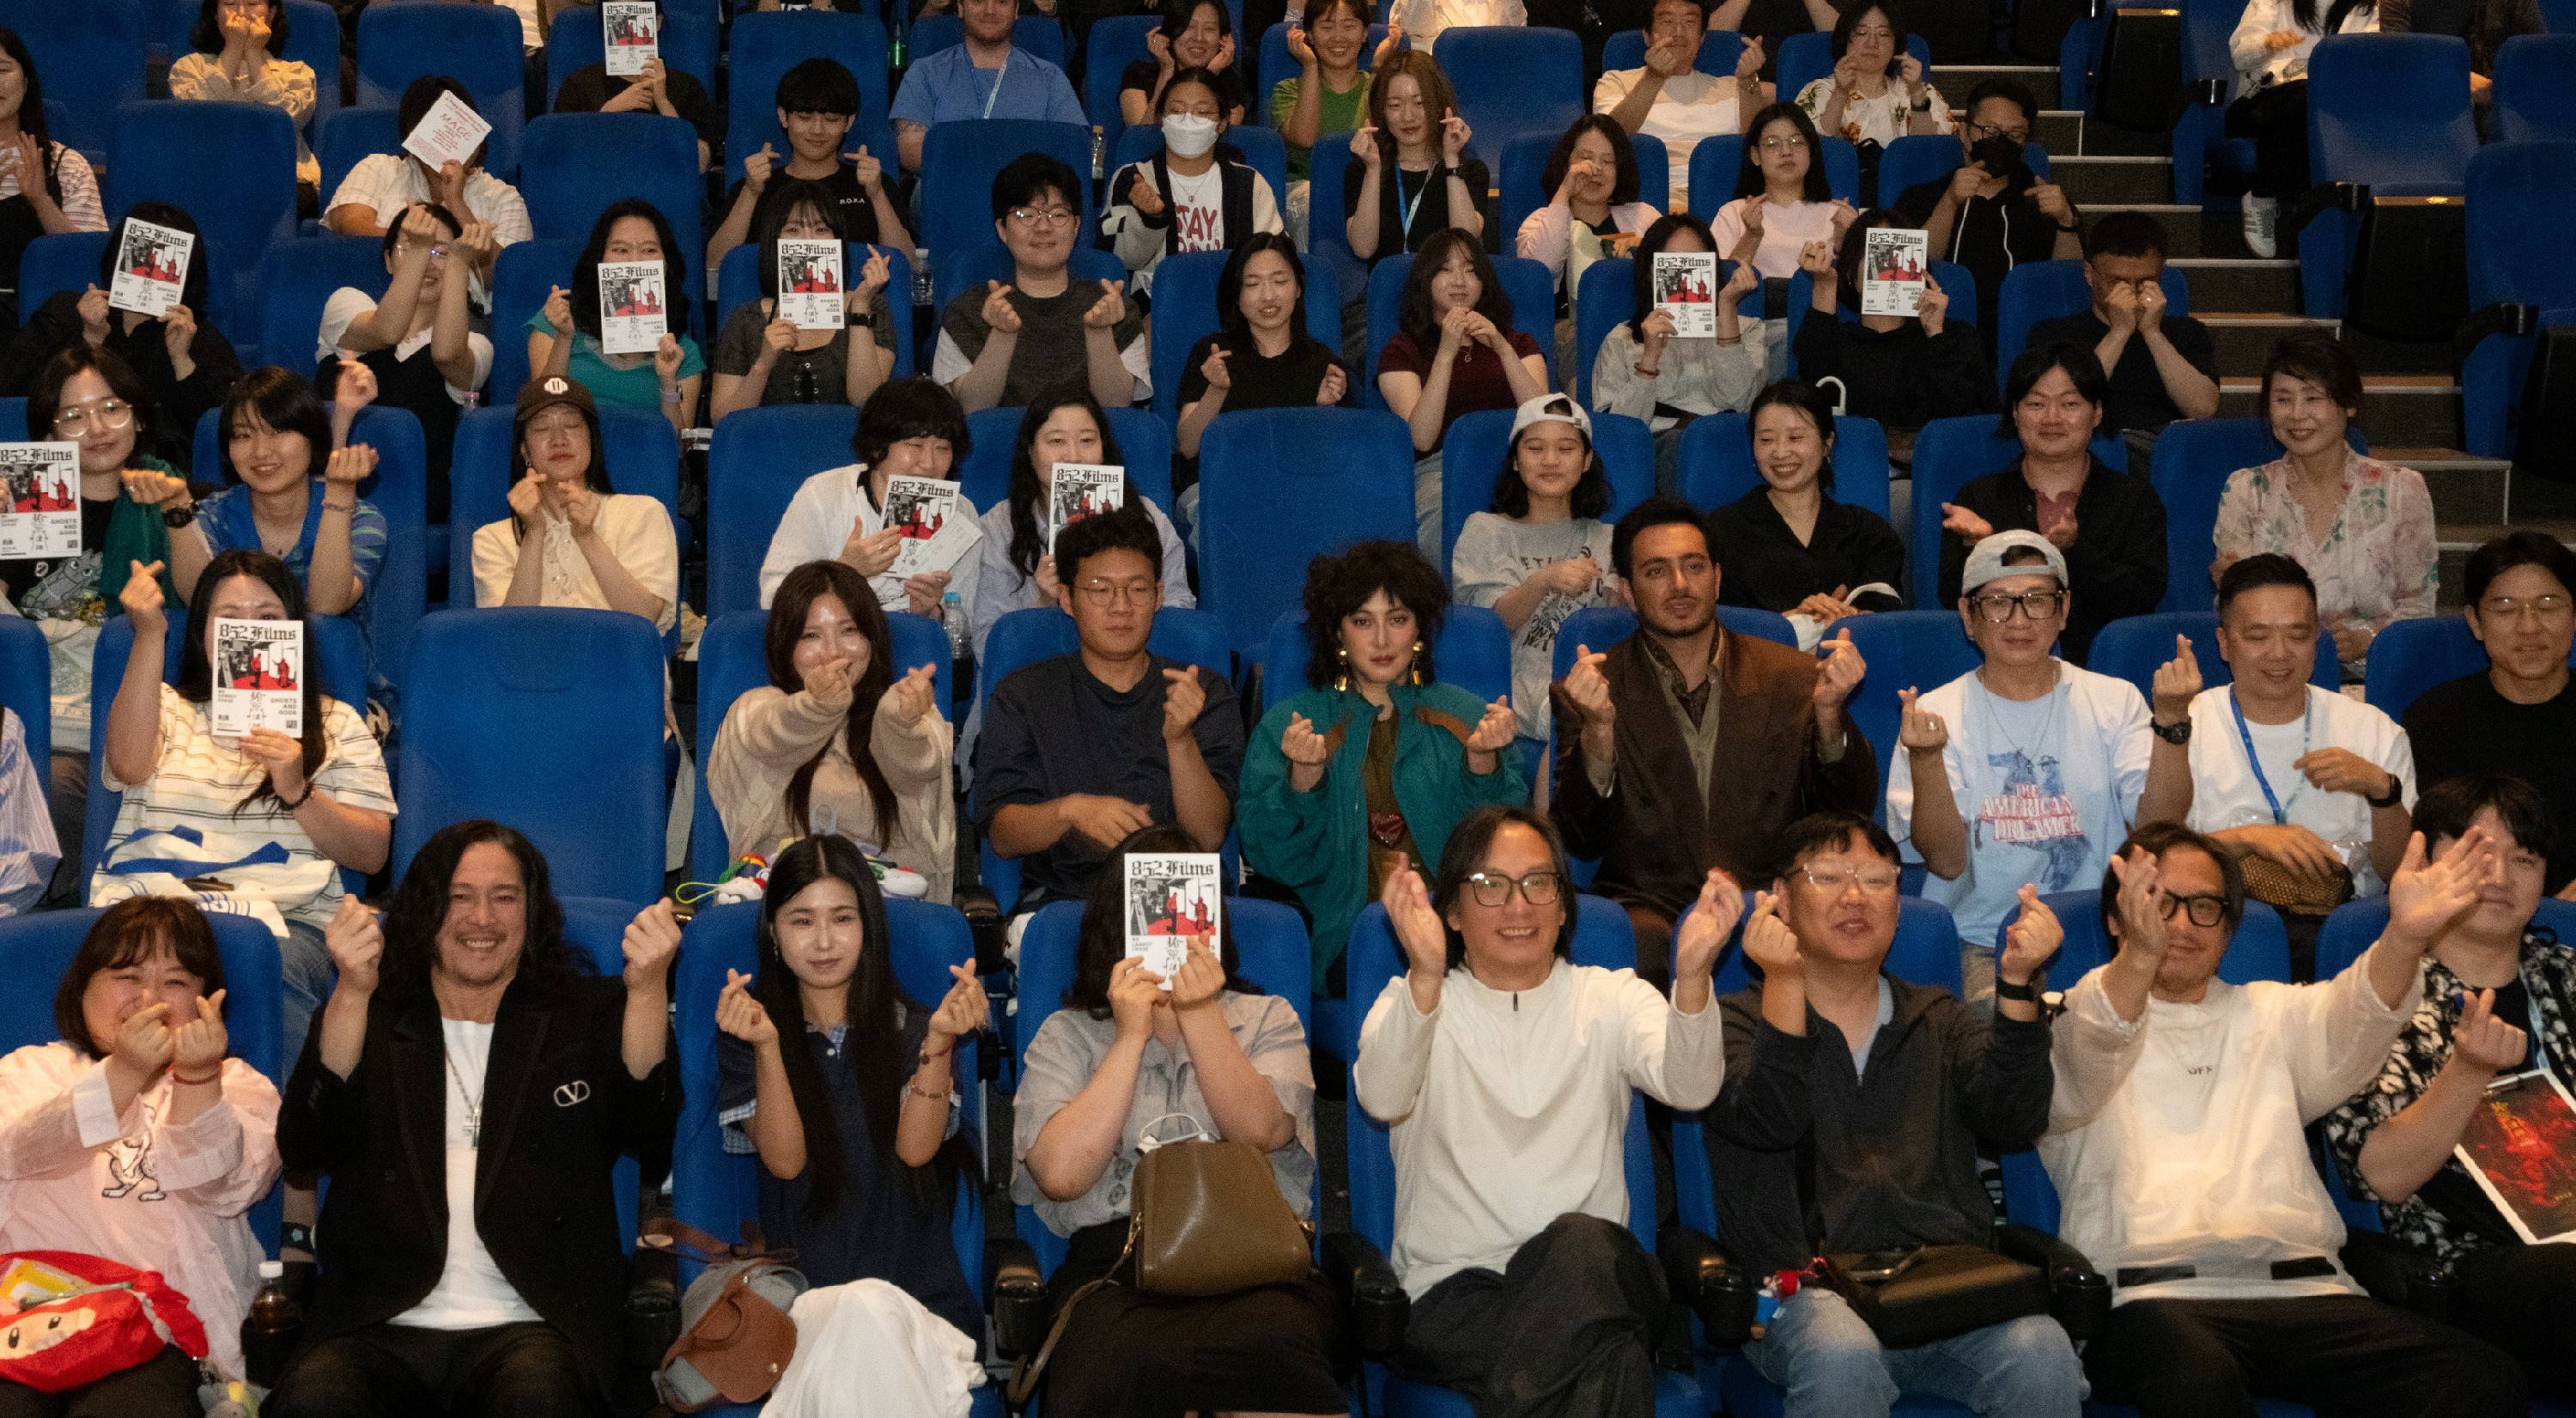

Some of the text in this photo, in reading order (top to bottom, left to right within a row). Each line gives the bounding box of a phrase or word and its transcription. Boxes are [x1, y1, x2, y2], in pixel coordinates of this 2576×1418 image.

[606, 4, 653, 15] 852 Films
[129, 223, 187, 246] 852 Films
[1869, 233, 1923, 245] 852 Films
[781, 243, 837, 256] 852 Films
[1657, 257, 1710, 268] 852 Films
[601, 266, 659, 279] 852 Films
[0, 448, 73, 463] 852 Films
[1056, 468, 1119, 483] 852 Films
[890, 480, 954, 497] 852 Films
[220, 624, 296, 641] 852 Films
[1979, 794, 2074, 819] AMERICAN
[1993, 816, 2084, 841] DREAMER
[1131, 860, 1214, 877] 852 Films
